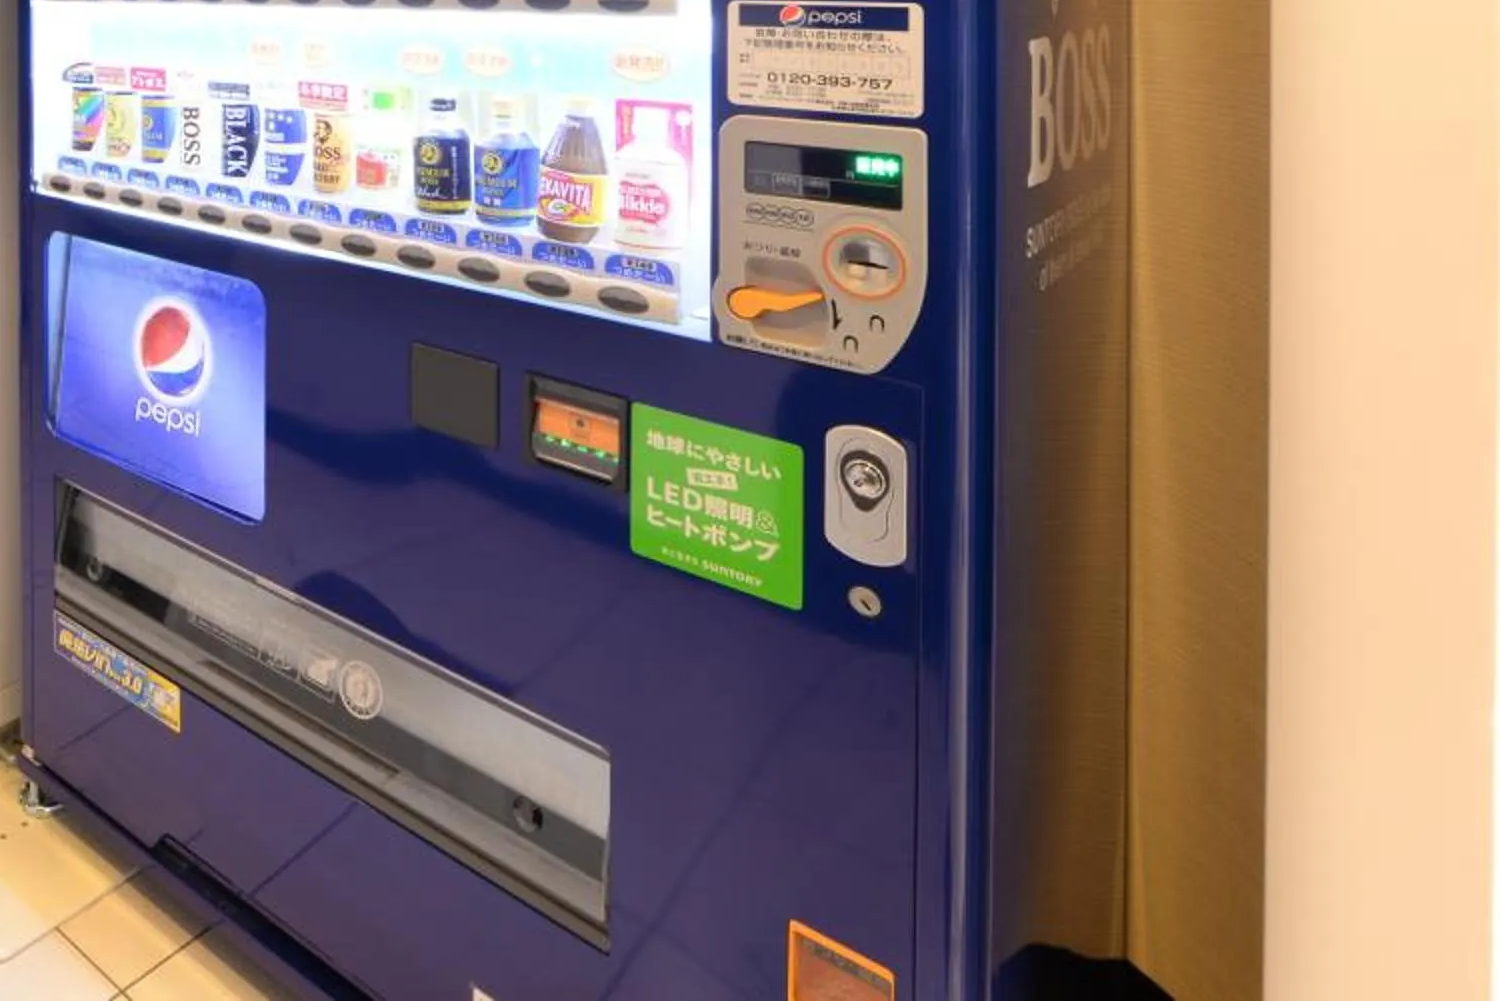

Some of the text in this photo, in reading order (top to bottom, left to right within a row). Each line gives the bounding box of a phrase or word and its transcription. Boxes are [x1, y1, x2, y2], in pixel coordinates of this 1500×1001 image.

[808, 9, 863, 26] pepsi
[766, 71, 893, 91] 0120-393-757
[1028, 33, 1111, 188] BOSS
[182, 106, 200, 166] BOSS
[225, 106, 248, 175] BLACK
[135, 396, 200, 437] pepsi
[646, 429, 782, 481] 地球にやさしい
[701, 559, 763, 587] SUNTORY
